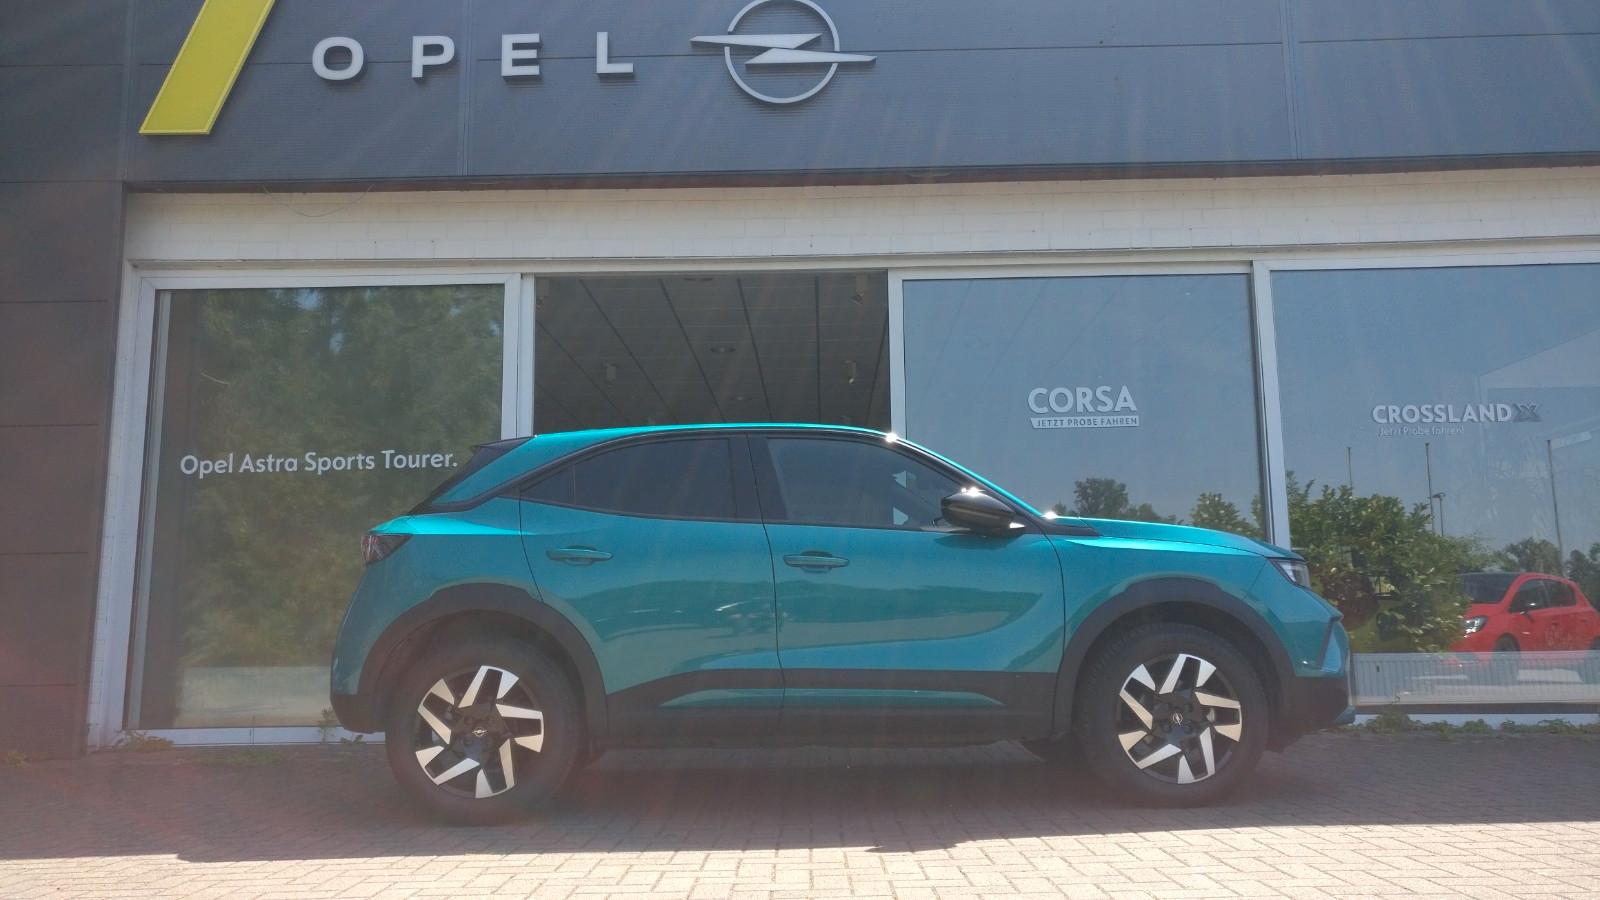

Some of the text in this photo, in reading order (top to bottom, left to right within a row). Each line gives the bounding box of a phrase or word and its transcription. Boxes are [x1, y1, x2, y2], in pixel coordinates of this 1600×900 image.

[312, 31, 634, 81] OPEL
[1027, 385, 1137, 414] CORSA
[1372, 404, 1512, 423] CROSSLAND
[1036, 417, 1137, 427] JETZT PROBE FAHREN
[180, 449, 458, 479] Opel Astra Sports Tourer.
